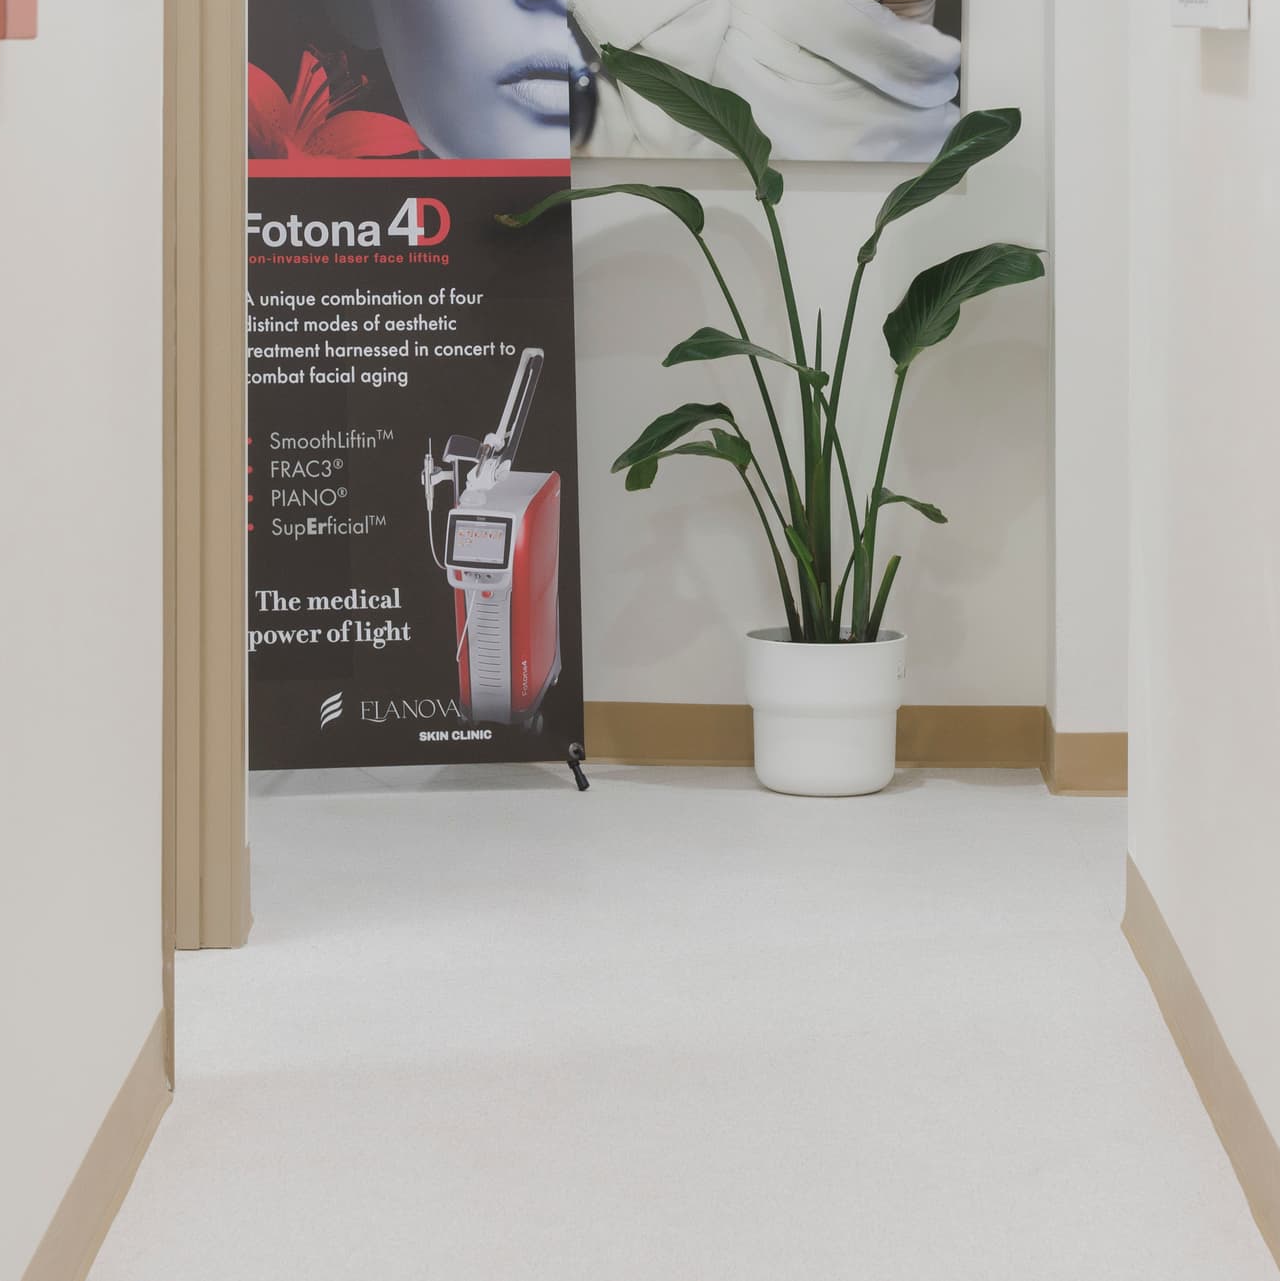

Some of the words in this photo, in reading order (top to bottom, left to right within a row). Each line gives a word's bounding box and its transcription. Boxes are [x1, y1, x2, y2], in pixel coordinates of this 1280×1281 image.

[388, 197, 451, 246] 4D
[248, 253, 329, 264] on-invasive
[334, 253, 369, 264] laser
[373, 252, 404, 264] face
[408, 252, 449, 265] lifting
[260, 290, 316, 311] unique
[321, 288, 423, 306] combination
[428, 288, 446, 305] of
[450, 287, 484, 305] four
[304, 314, 358, 332] modes
[363, 314, 380, 331] of
[385, 313, 457, 331] aesthetic
[248, 343, 320, 358] reatment
[325, 339, 409, 357] harnessed
[415, 341, 429, 357] in
[434, 341, 496, 357] concert
[500, 341, 516, 356] to
[309, 365, 355, 383] facial
[360, 367, 408, 387] aging
[255, 590, 301, 612] The
[306, 587, 402, 611] medical
[248, 628, 322, 652] power
[327, 619, 353, 643] of
[355, 620, 412, 649] light
[419, 730, 449, 742] SKIN
[451, 729, 493, 741] CLINIC
